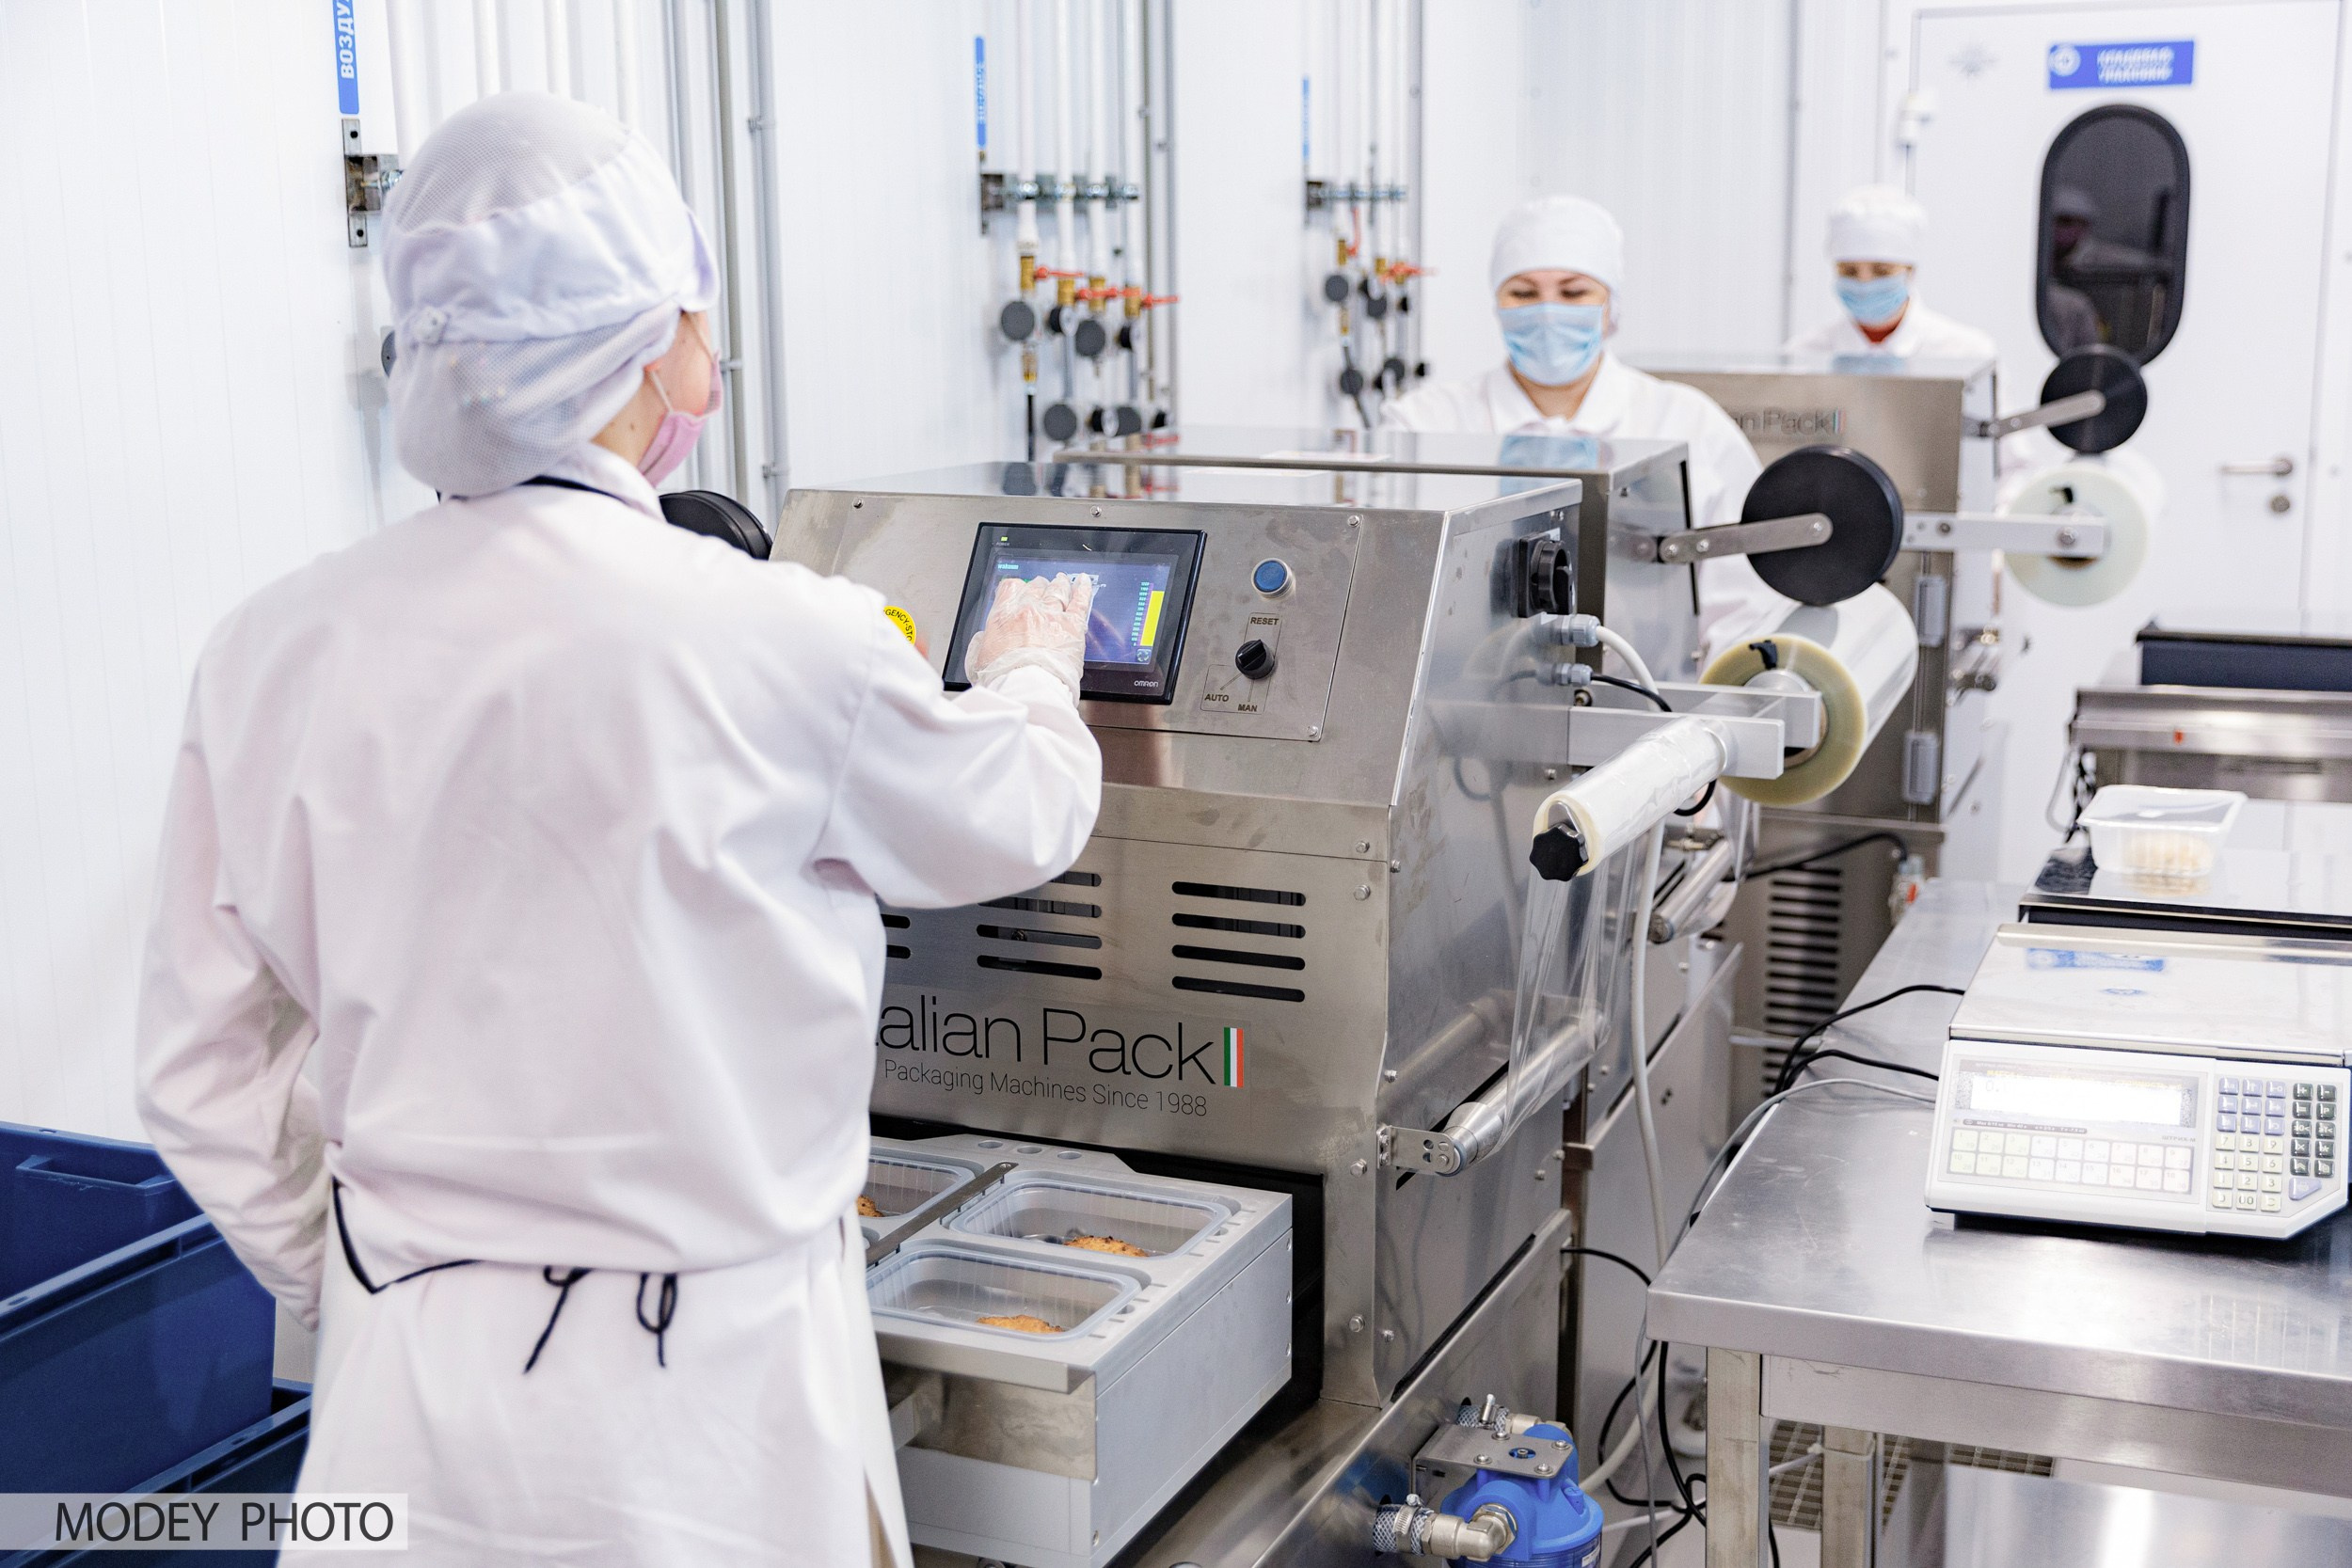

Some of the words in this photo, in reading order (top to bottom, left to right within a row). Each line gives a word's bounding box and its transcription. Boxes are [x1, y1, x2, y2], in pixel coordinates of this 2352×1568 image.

[336, 0, 355, 79] ВОЗДУ
[883, 609, 914, 641] GENCY-STO
[1250, 617, 1279, 626] RESET
[1204, 693, 1230, 702] AUTO
[1237, 704, 1258, 712] MAN
[875, 994, 1022, 1062] alian
[1042, 1007, 1216, 1085] Pack
[884, 1059, 984, 1096] Packaging
[991, 1071, 1087, 1102] Machines
[1092, 1084, 1149, 1111] Since
[1156, 1091, 1208, 1117] 1988
[2270, 1140, 2277, 1148] 9
[2269, 1159, 2276, 1167] 6
[2245, 1177, 2251, 1185] 2
[2268, 1179, 2275, 1187] 3
